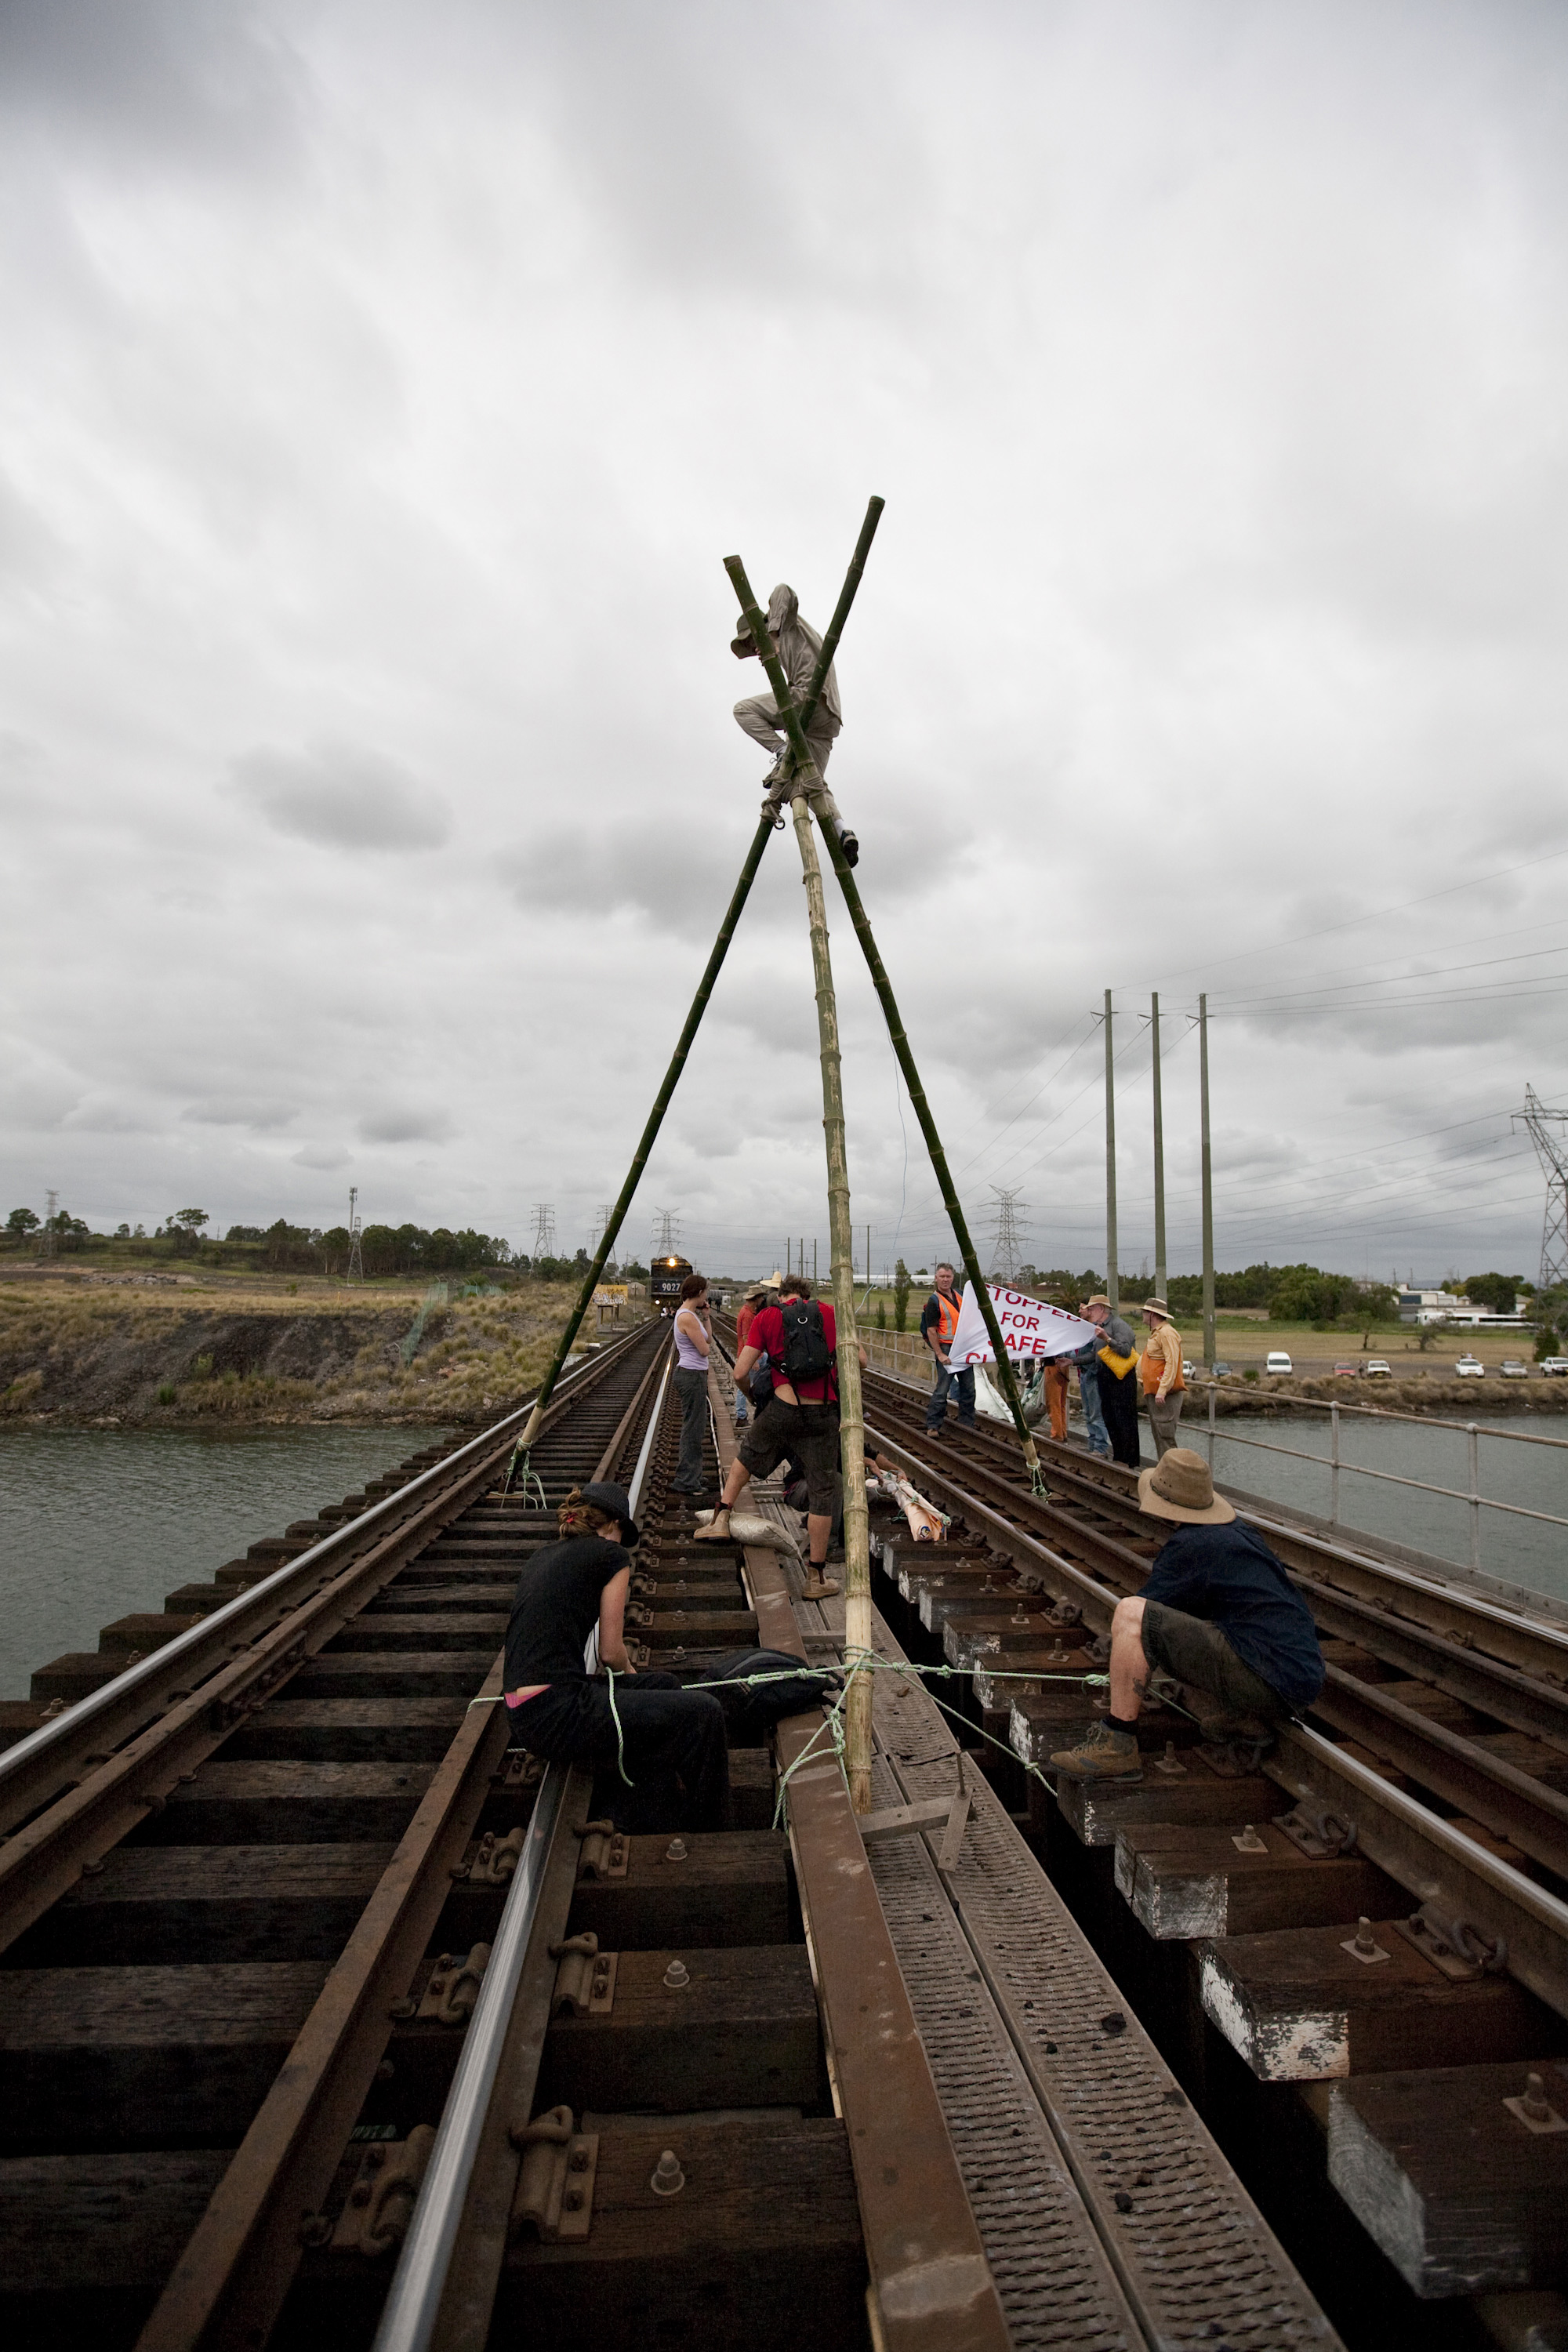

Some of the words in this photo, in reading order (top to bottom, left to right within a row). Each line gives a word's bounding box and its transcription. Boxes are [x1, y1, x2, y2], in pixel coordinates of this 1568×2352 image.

[662, 1283, 681, 1291] 9027
[1000, 1312, 1040, 1331] FOR
[988, 1334, 1047, 1355] AFE
